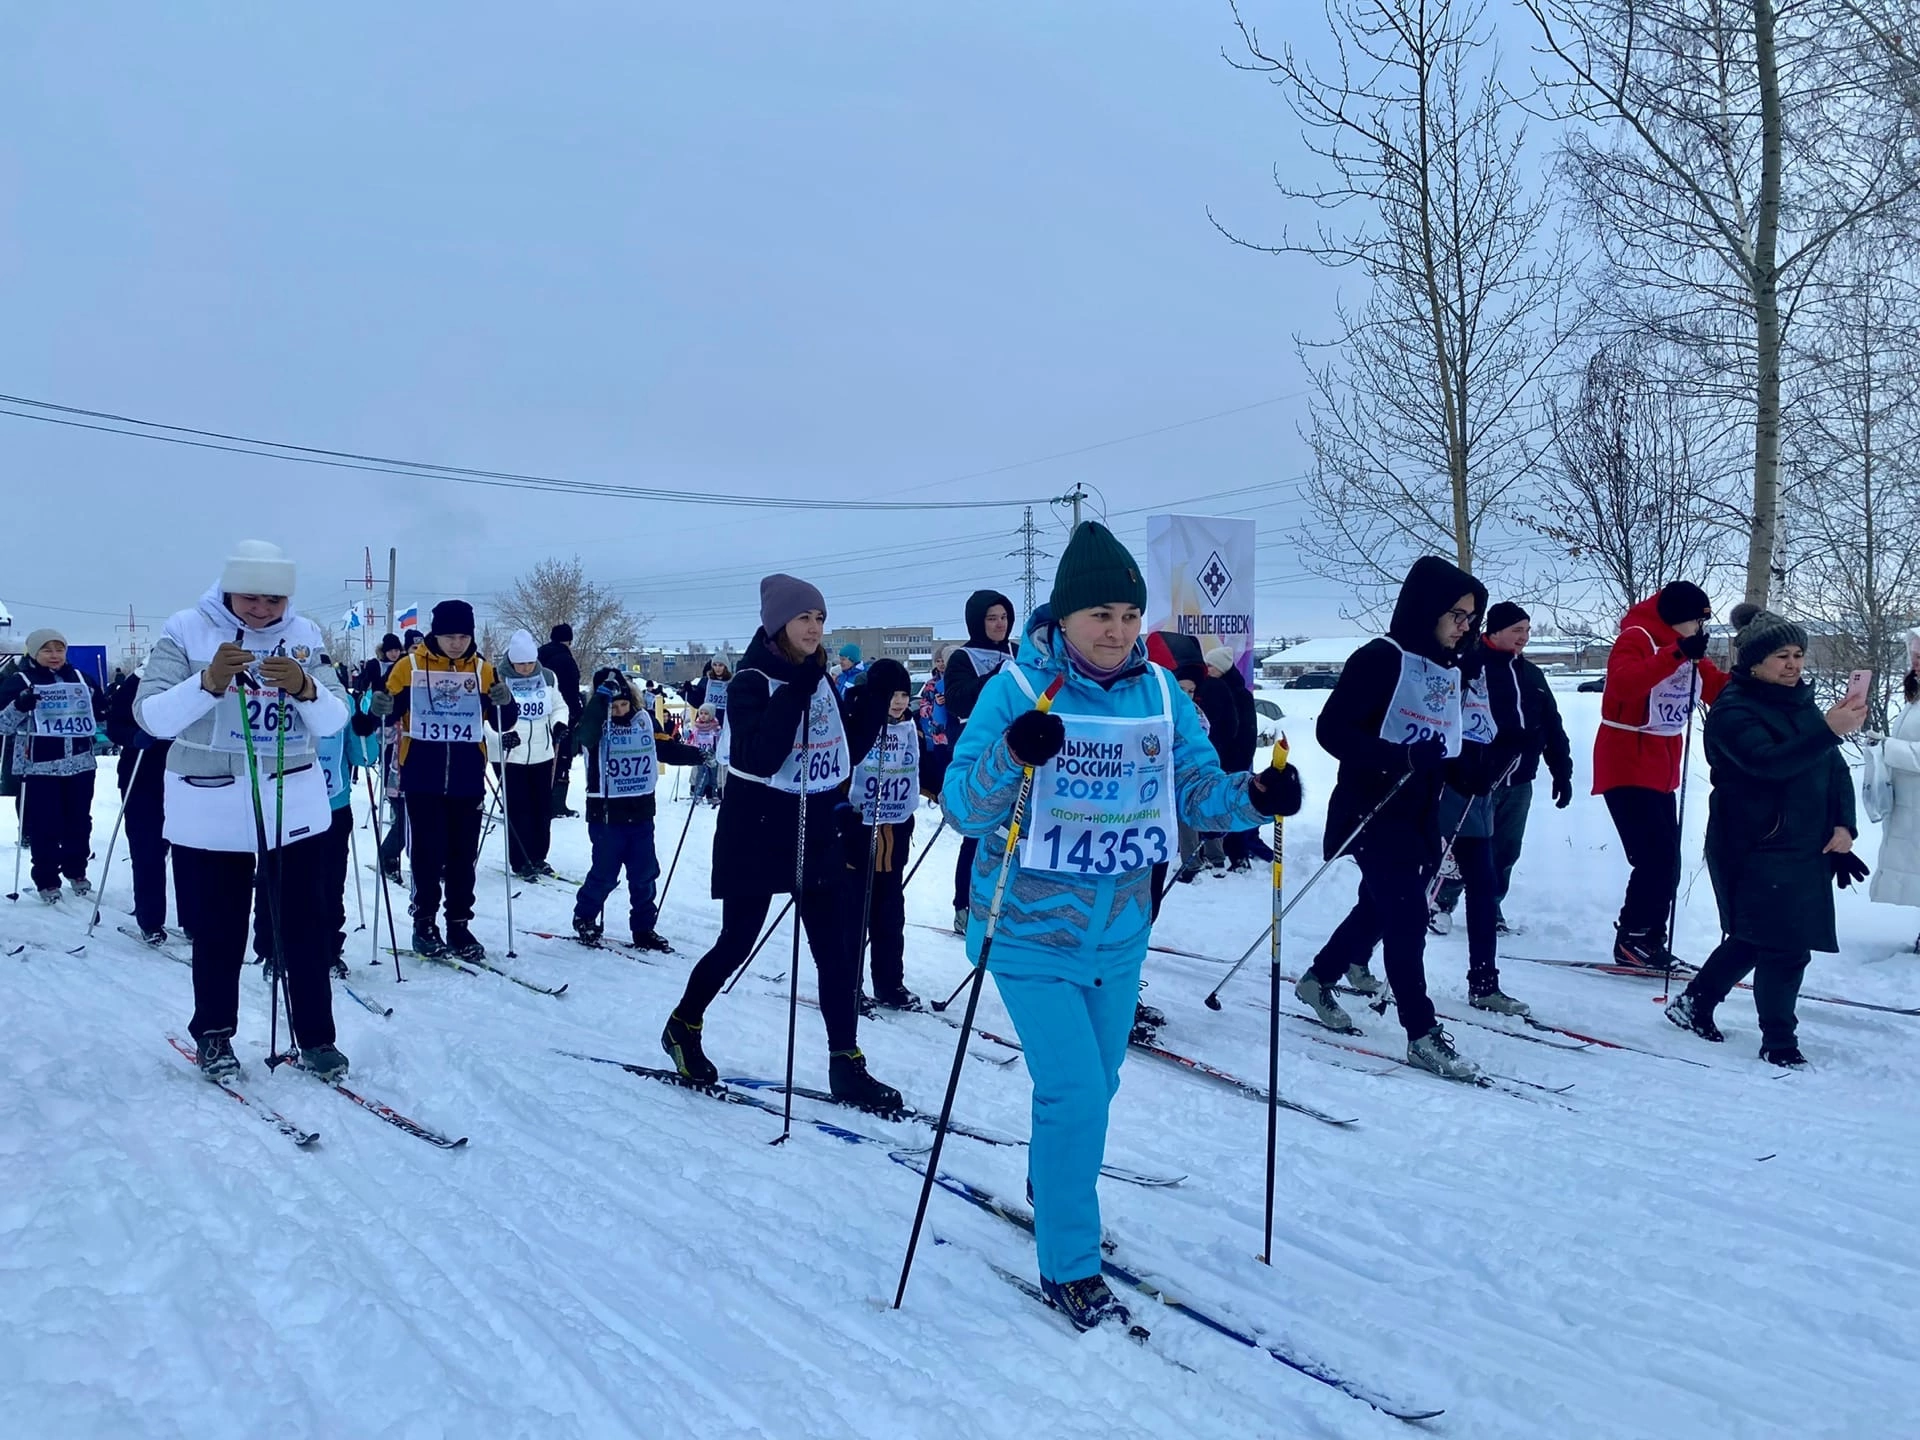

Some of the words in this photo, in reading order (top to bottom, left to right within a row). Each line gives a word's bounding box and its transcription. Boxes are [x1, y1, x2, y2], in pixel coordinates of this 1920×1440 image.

[1178, 614, 1250, 634] МЕНДЕЛЕЕВСК
[42, 717, 92, 733] 14430
[247, 700, 297, 732] 266
[421, 722, 472, 740] 13194
[608, 756, 651, 777] 9372
[1056, 757, 1122, 777] РОССИИ
[864, 776, 911, 801] 9412
[1054, 777, 1119, 800] 2022
[1050, 807, 1085, 823] СПОРТ
[1044, 825, 1168, 874] 14353
